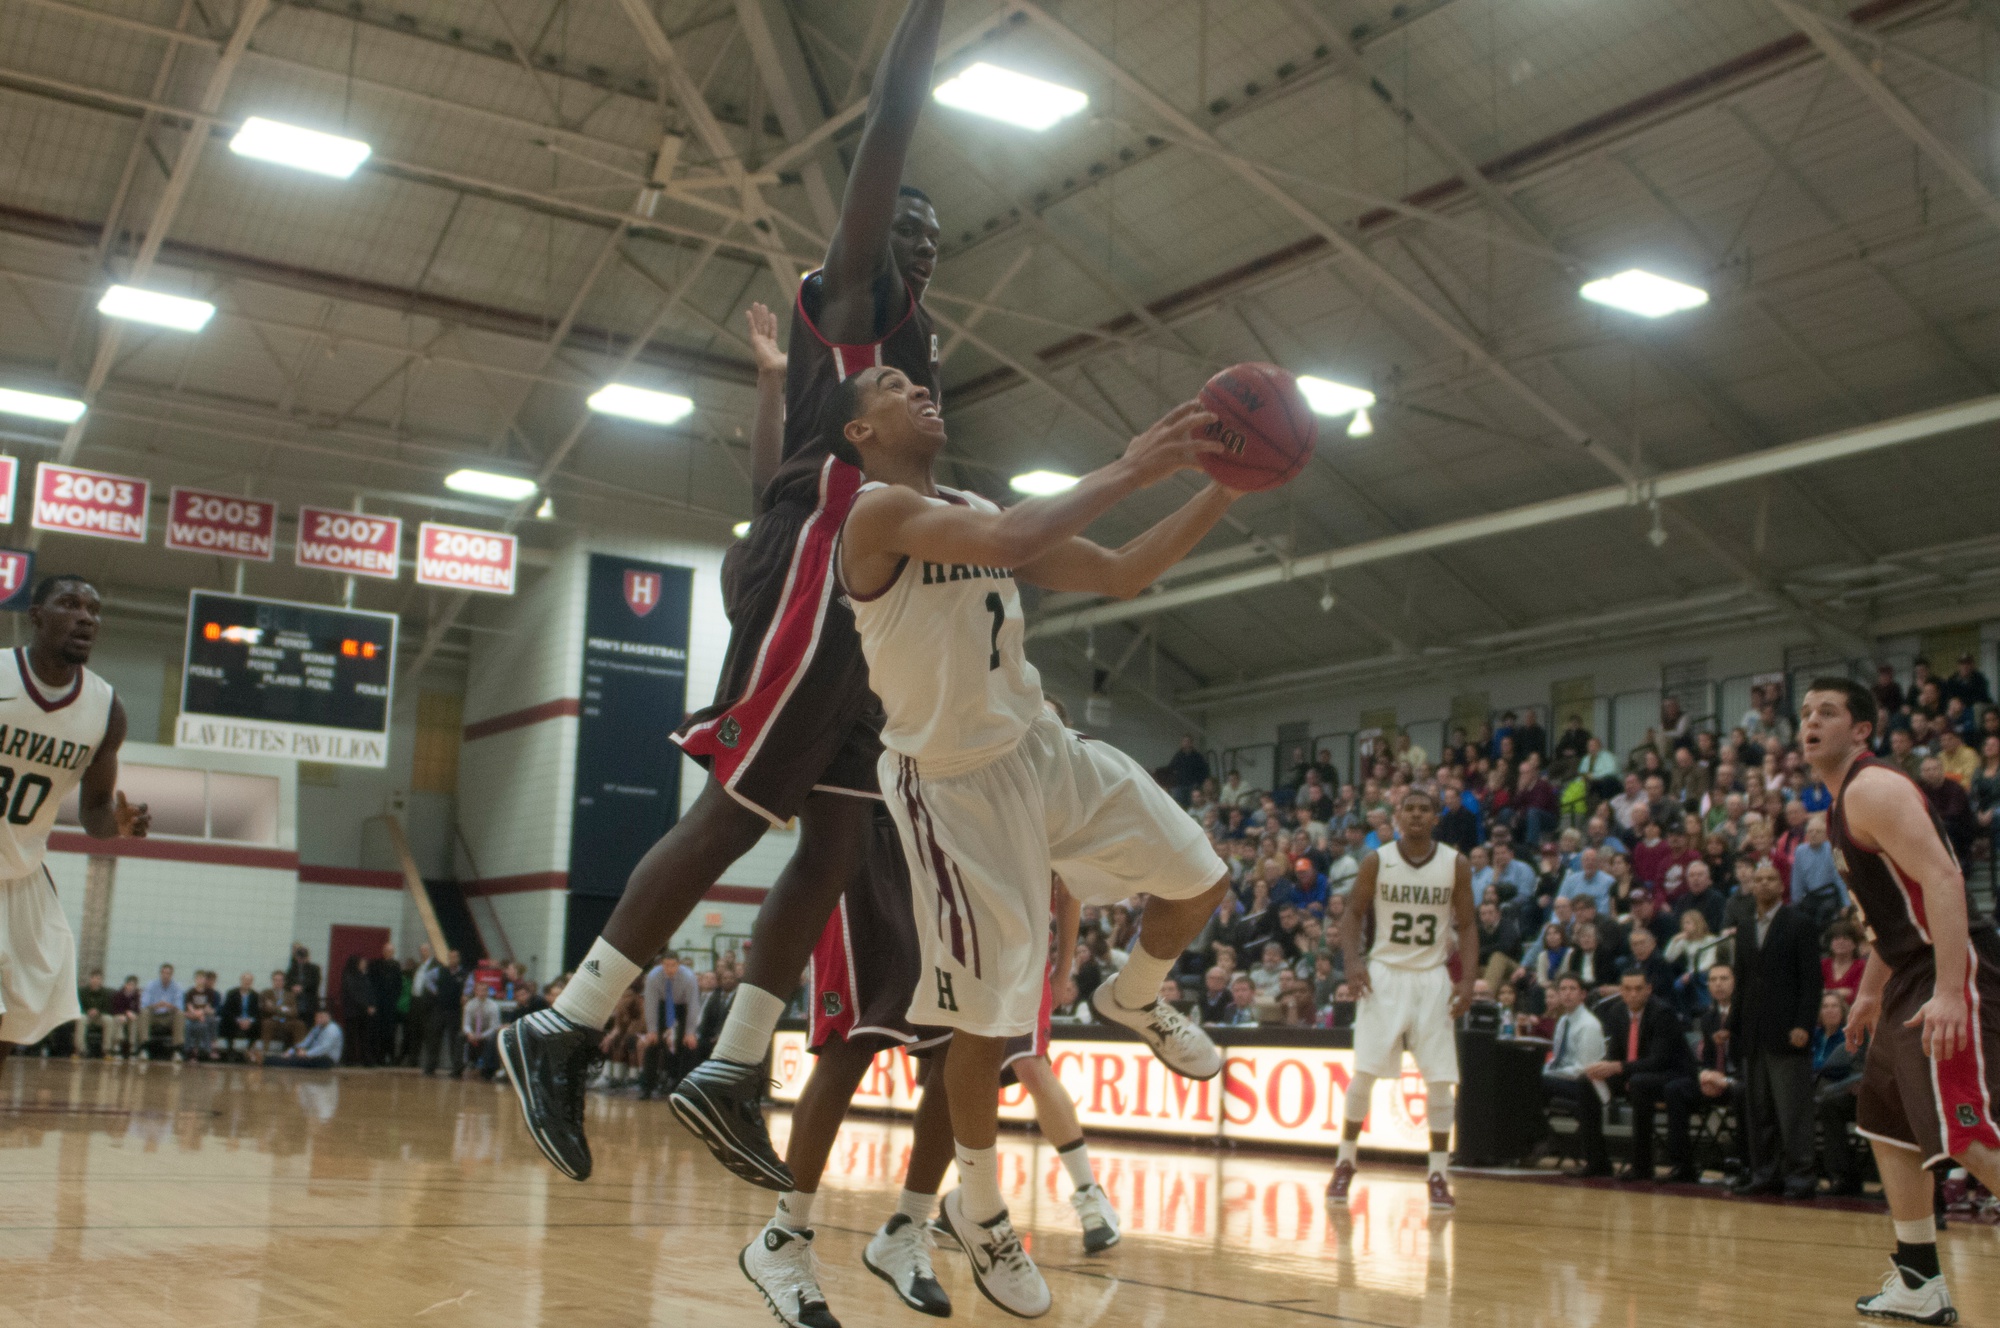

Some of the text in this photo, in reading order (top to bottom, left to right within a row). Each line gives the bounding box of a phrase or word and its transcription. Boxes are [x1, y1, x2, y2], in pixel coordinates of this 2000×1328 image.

[53, 473, 134, 507] 2003
[39, 500, 142, 535] WOMEN
[186, 496, 261, 527] 2005
[172, 521, 270, 554] WOMEN
[315, 515, 387, 544] 2007
[301, 540, 394, 571] WOMEN
[434, 531, 503, 562] 2008
[422, 557, 510, 587] WOMEN
[632, 575, 652, 605] H
[985, 591, 1004, 671] 1
[622, 642, 686, 660] BASKETBALL
[181, 721, 381, 760] LAVIETES PAVILION
[1380, 884, 1451, 905] HARVARD
[1390, 911, 1437, 946] 23
[935, 966, 959, 1012] H
